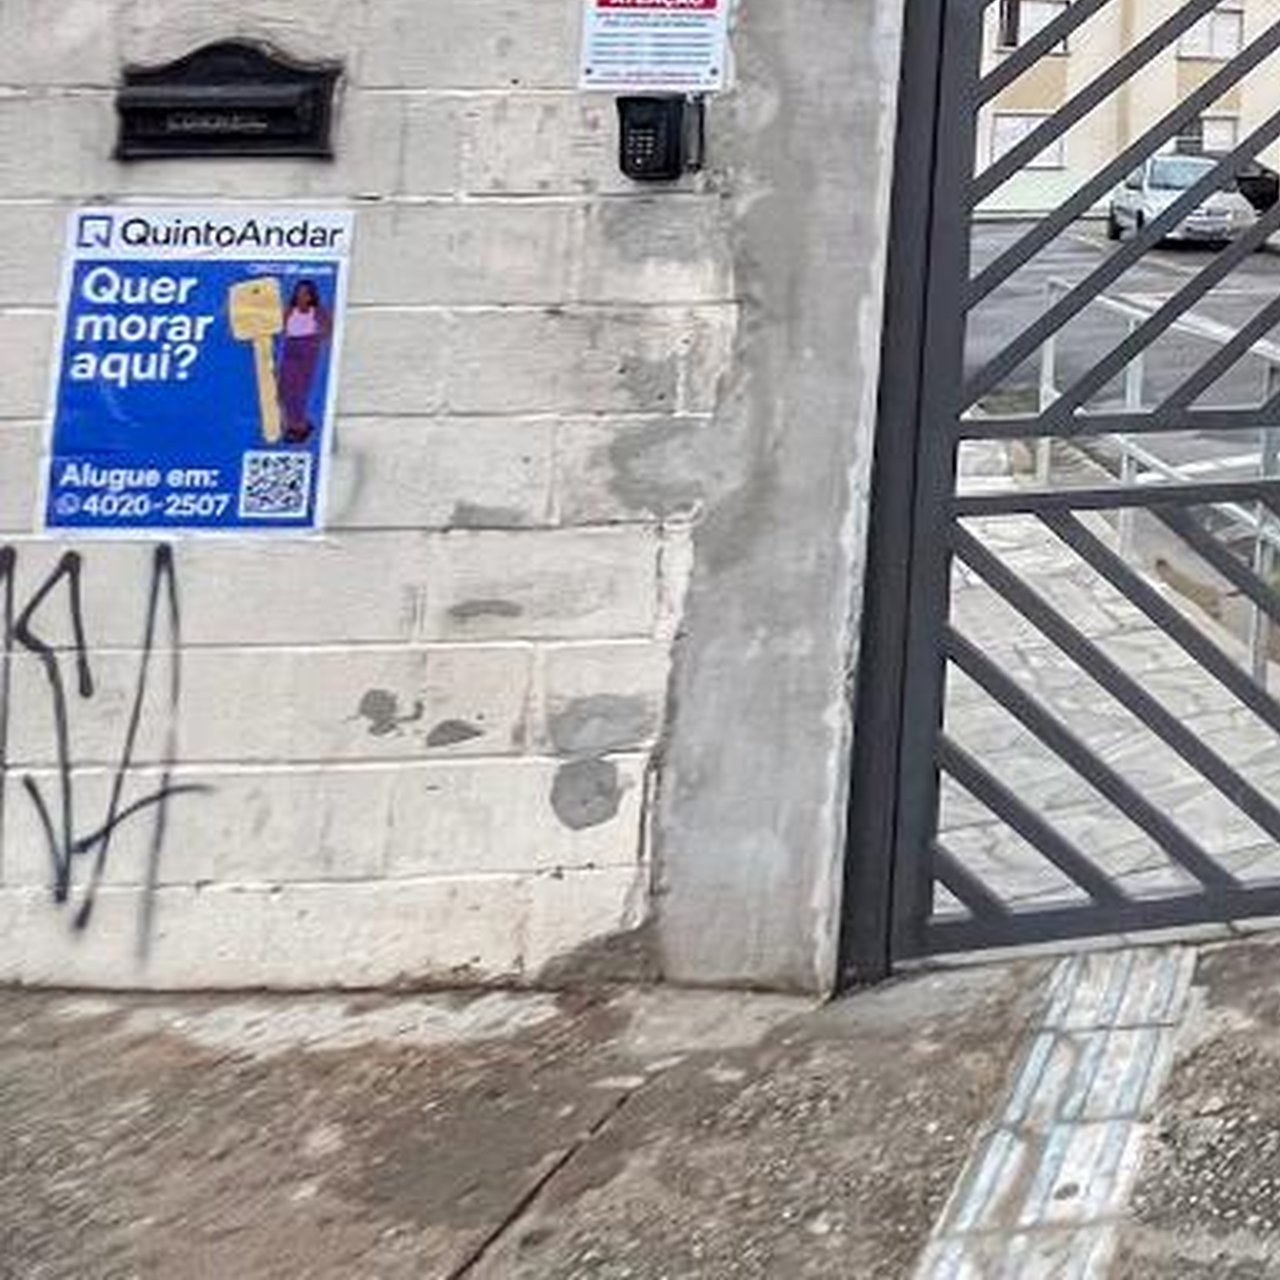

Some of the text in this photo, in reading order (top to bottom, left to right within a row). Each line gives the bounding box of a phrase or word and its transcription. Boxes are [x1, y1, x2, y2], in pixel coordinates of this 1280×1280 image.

[121, 218, 343, 248] QuintoAndar
[82, 267, 198, 305] Quer
[74, 312, 214, 341] morar
[70, 343, 198, 387] aqui?
[60, 464, 219, 491] Alugue em:
[82, 493, 231, 516] 4020-2507
